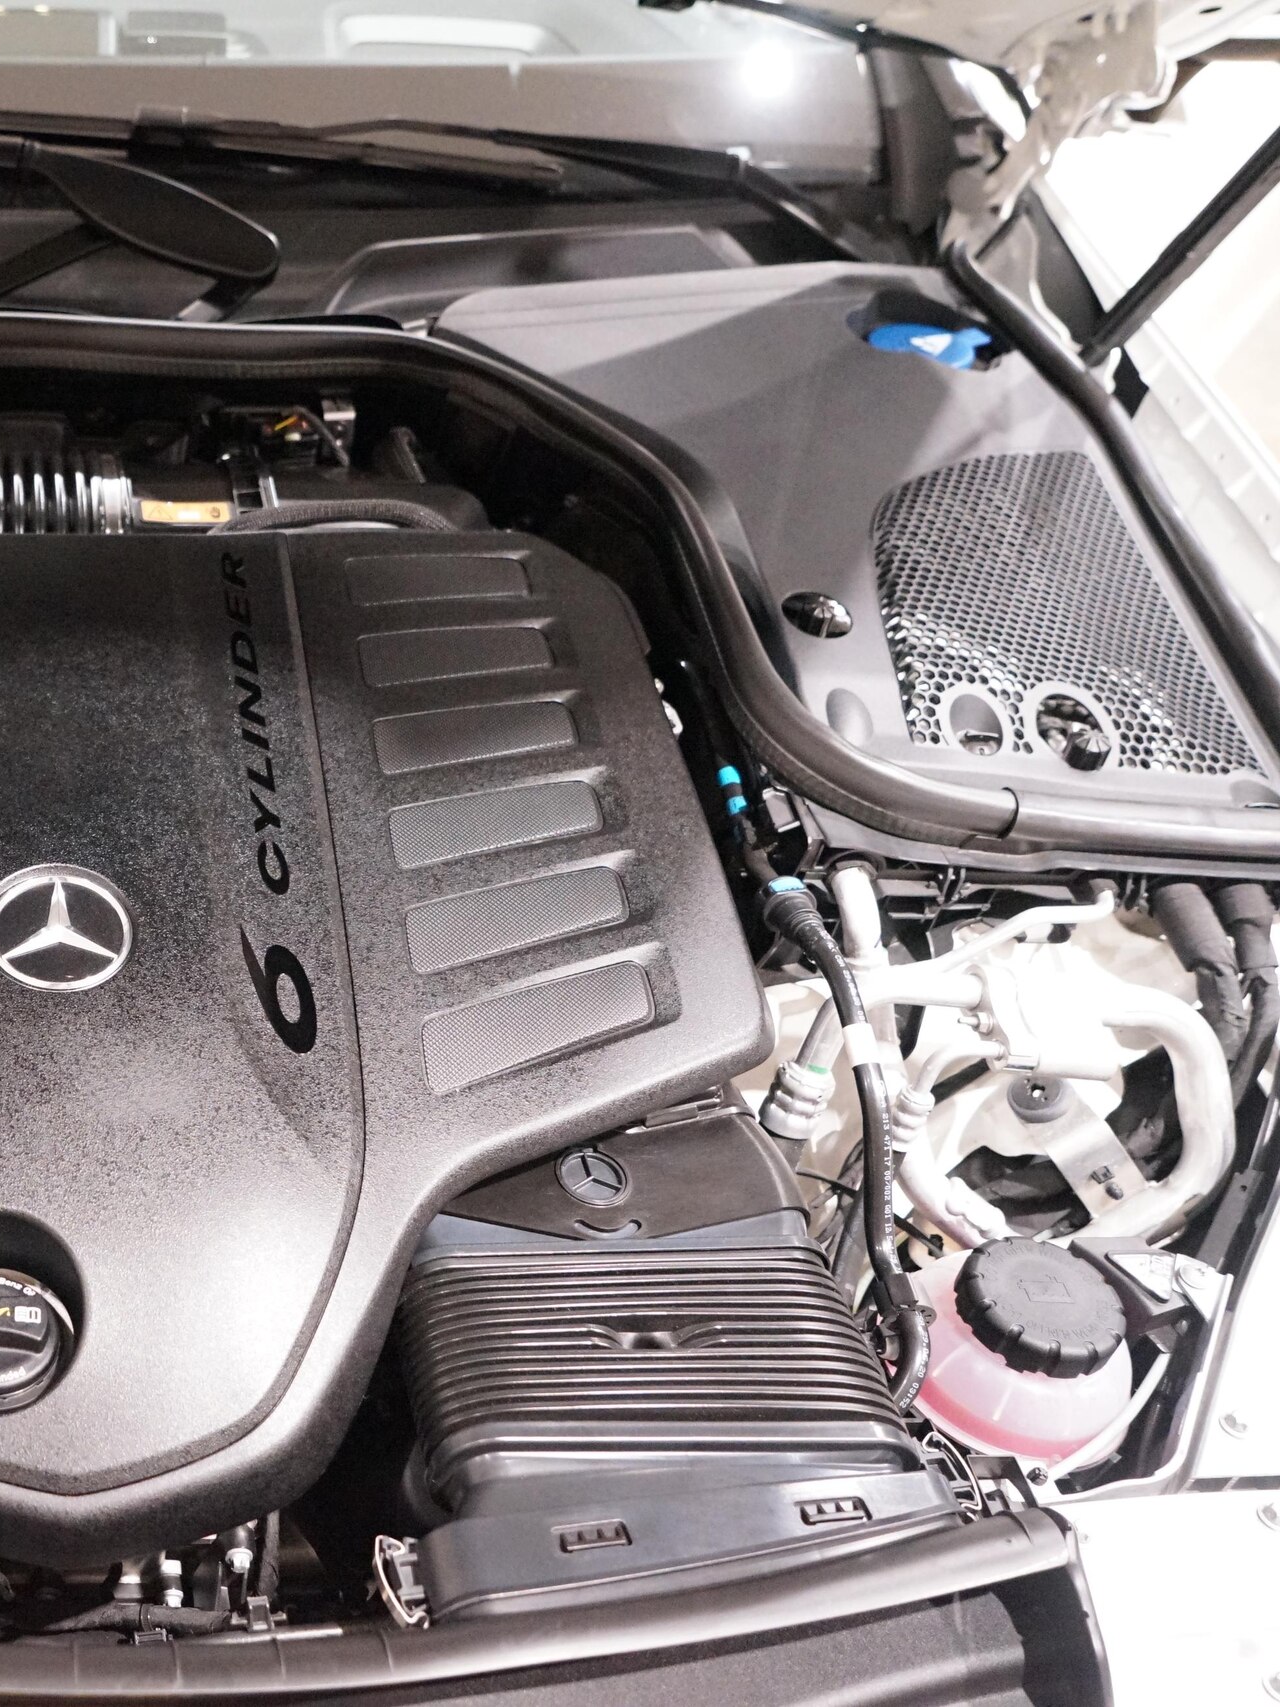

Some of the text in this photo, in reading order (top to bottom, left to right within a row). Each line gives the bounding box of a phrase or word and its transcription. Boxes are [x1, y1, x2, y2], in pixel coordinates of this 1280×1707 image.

[220, 551, 318, 1055] 6 CYLINDER
[882, 1112, 890, 1131] 213
[884, 1156, 891, 1166] 17
